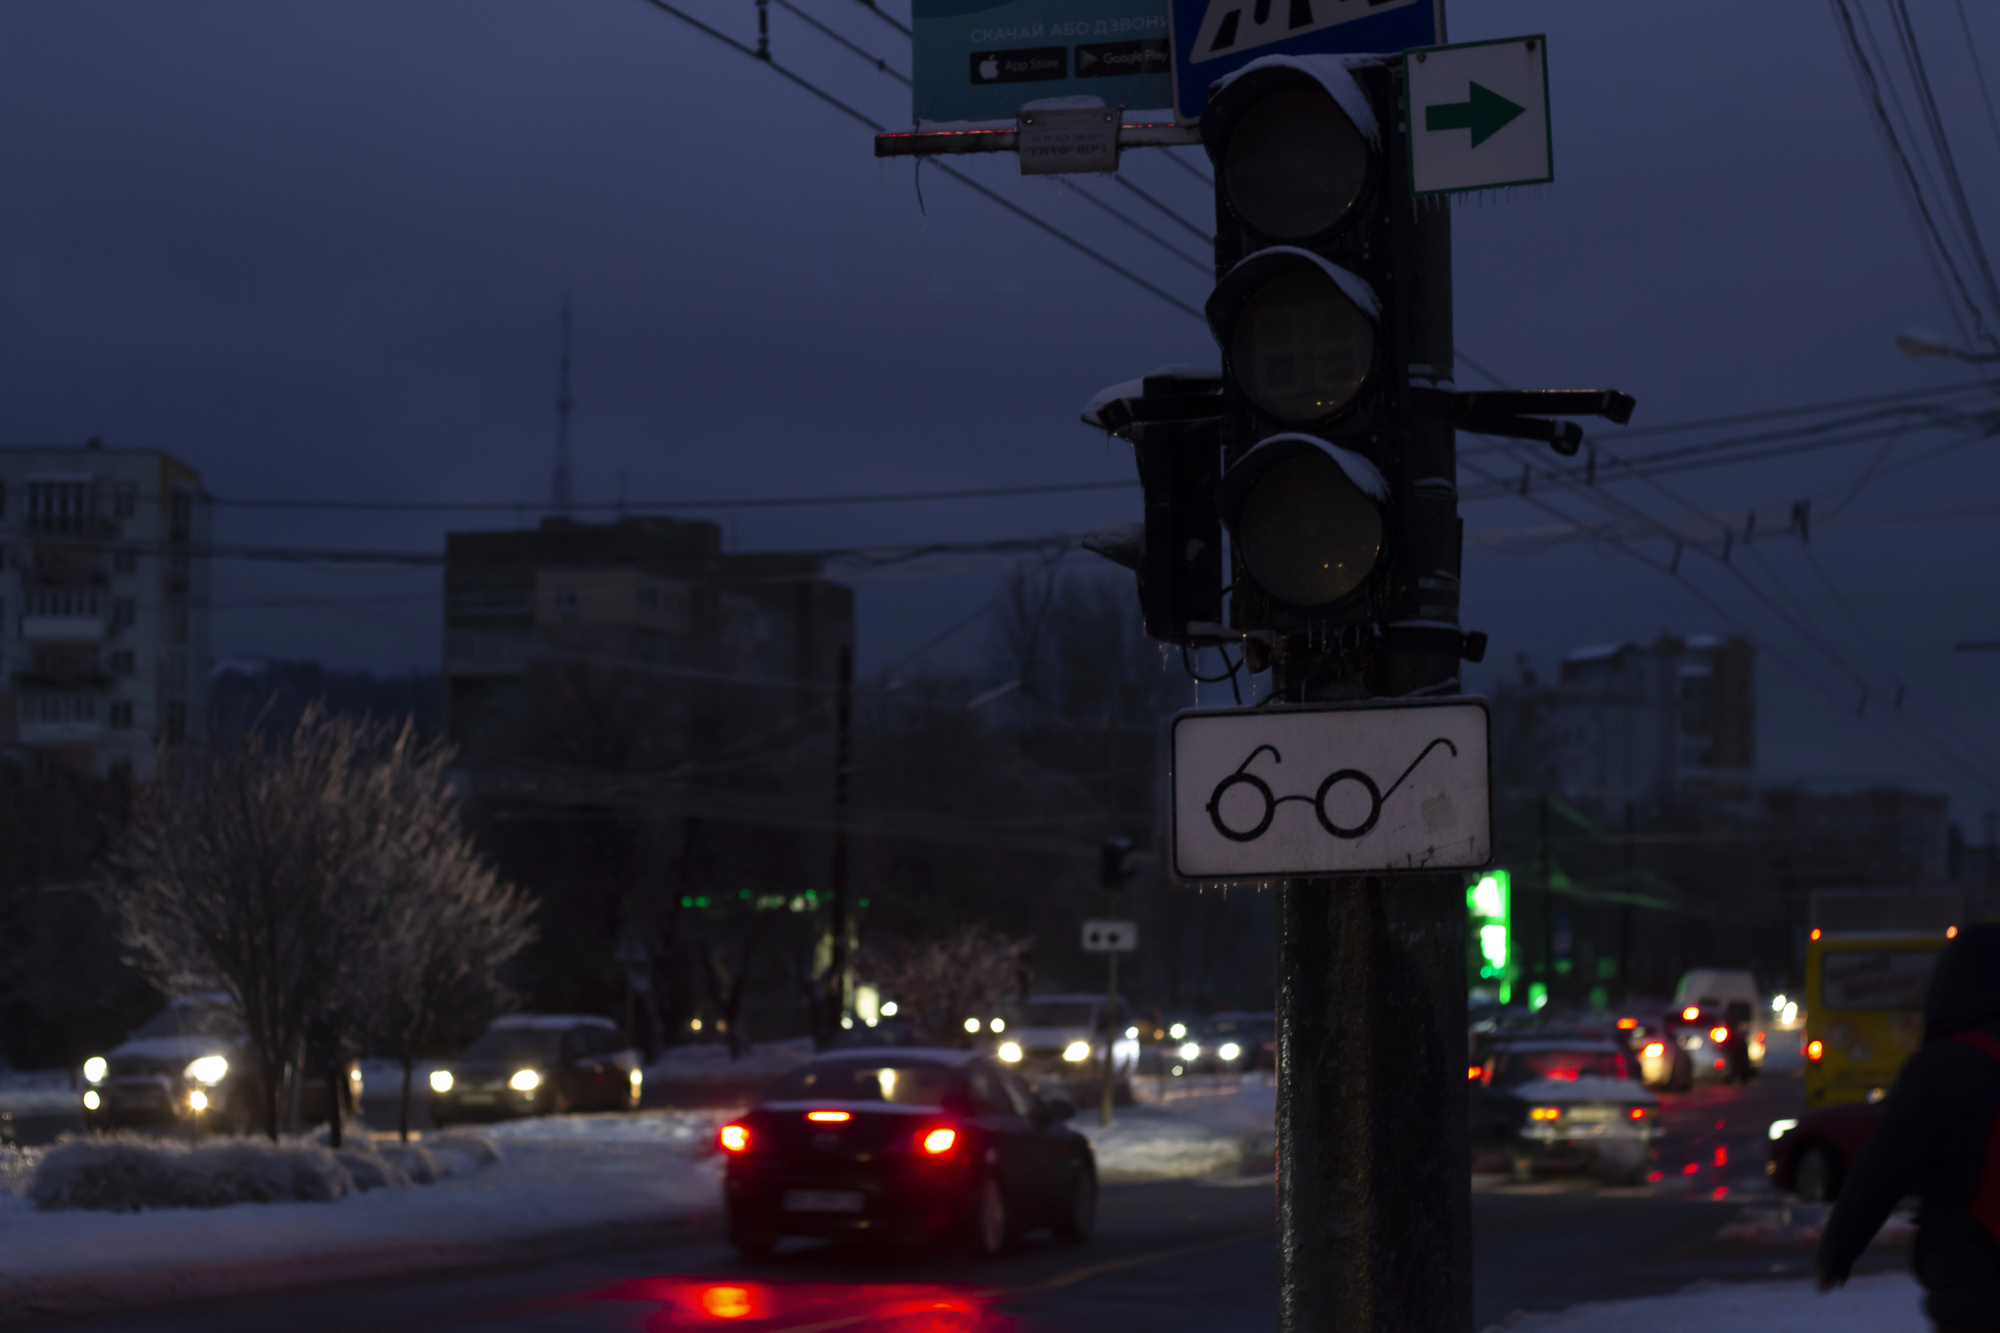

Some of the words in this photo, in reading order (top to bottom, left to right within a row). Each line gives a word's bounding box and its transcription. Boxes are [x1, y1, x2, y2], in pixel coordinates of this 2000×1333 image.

[970, 23, 1044, 43] СКАЧАЙ
[1050, 21, 1089, 36] АБО
[1004, 60, 1028, 72] App
[1030, 58, 1059, 70] Store
[1103, 52, 1142, 66] Google
[1144, 50, 1169, 63] Play
